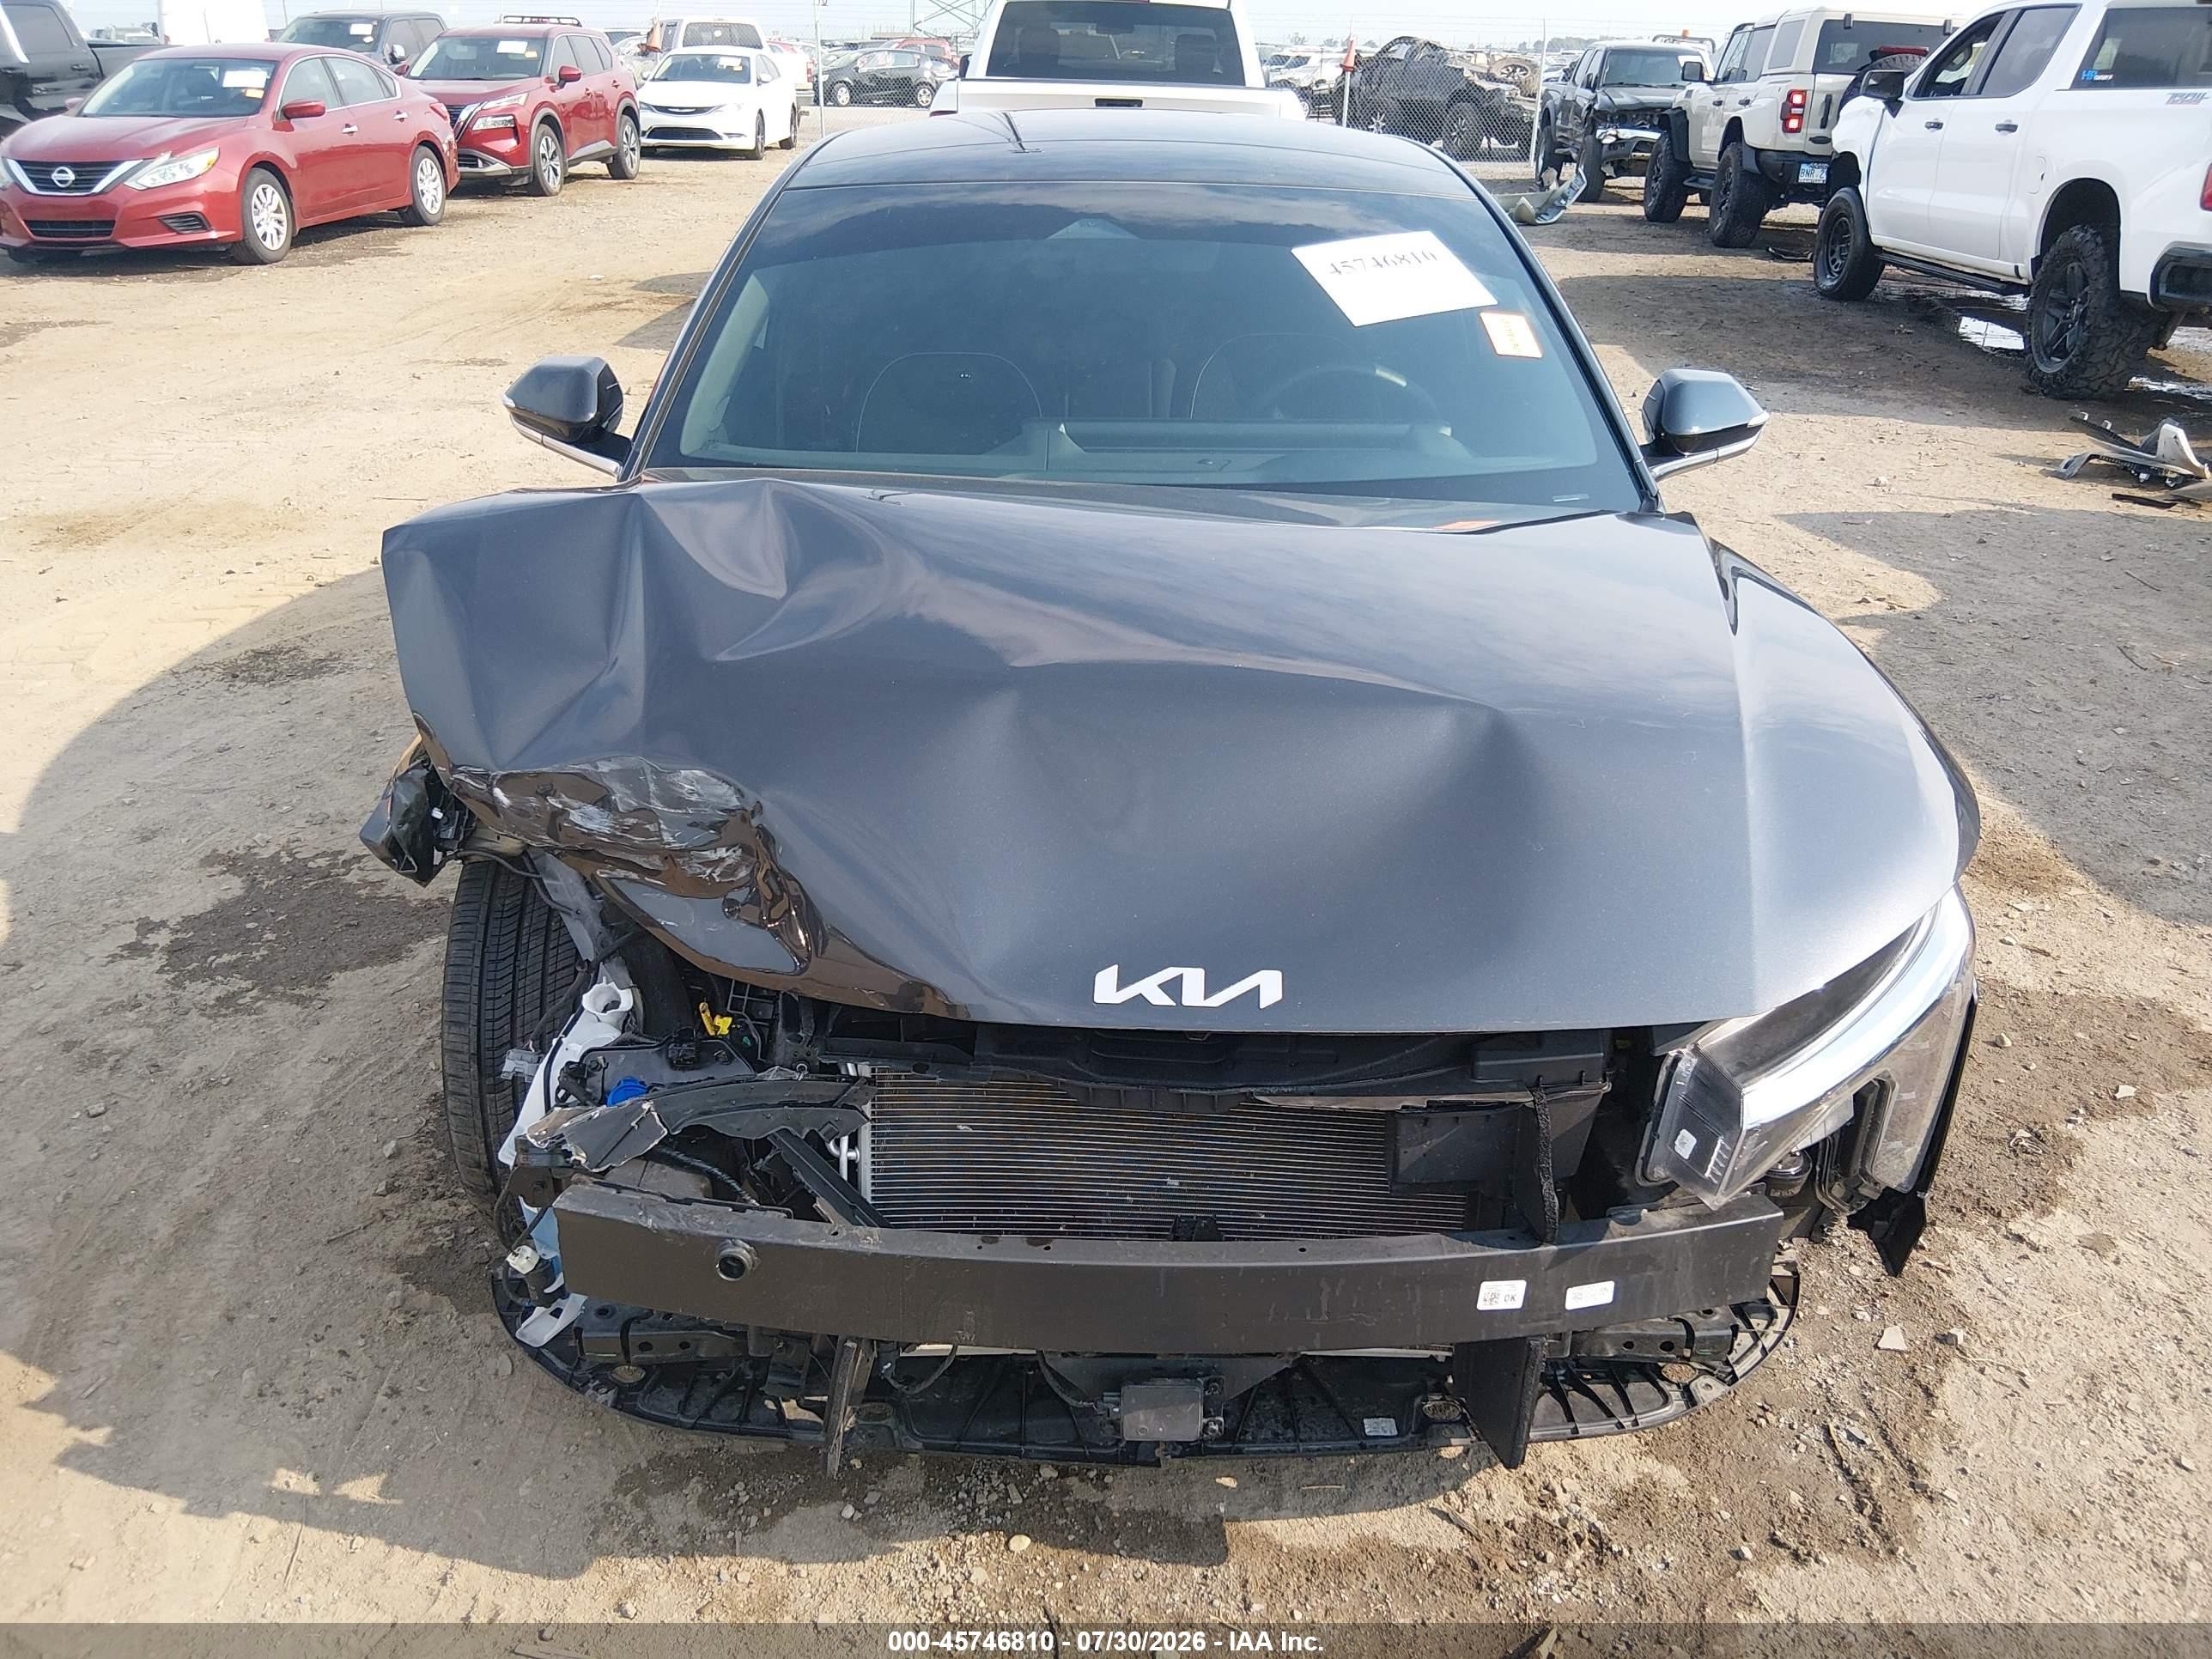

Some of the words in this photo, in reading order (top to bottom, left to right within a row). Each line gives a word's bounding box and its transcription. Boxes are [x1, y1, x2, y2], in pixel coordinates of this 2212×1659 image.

[1800, 168, 1815, 178] BNR
[1093, 963, 1283, 1010] KIA
[1504, 1293, 1517, 1303] OK
